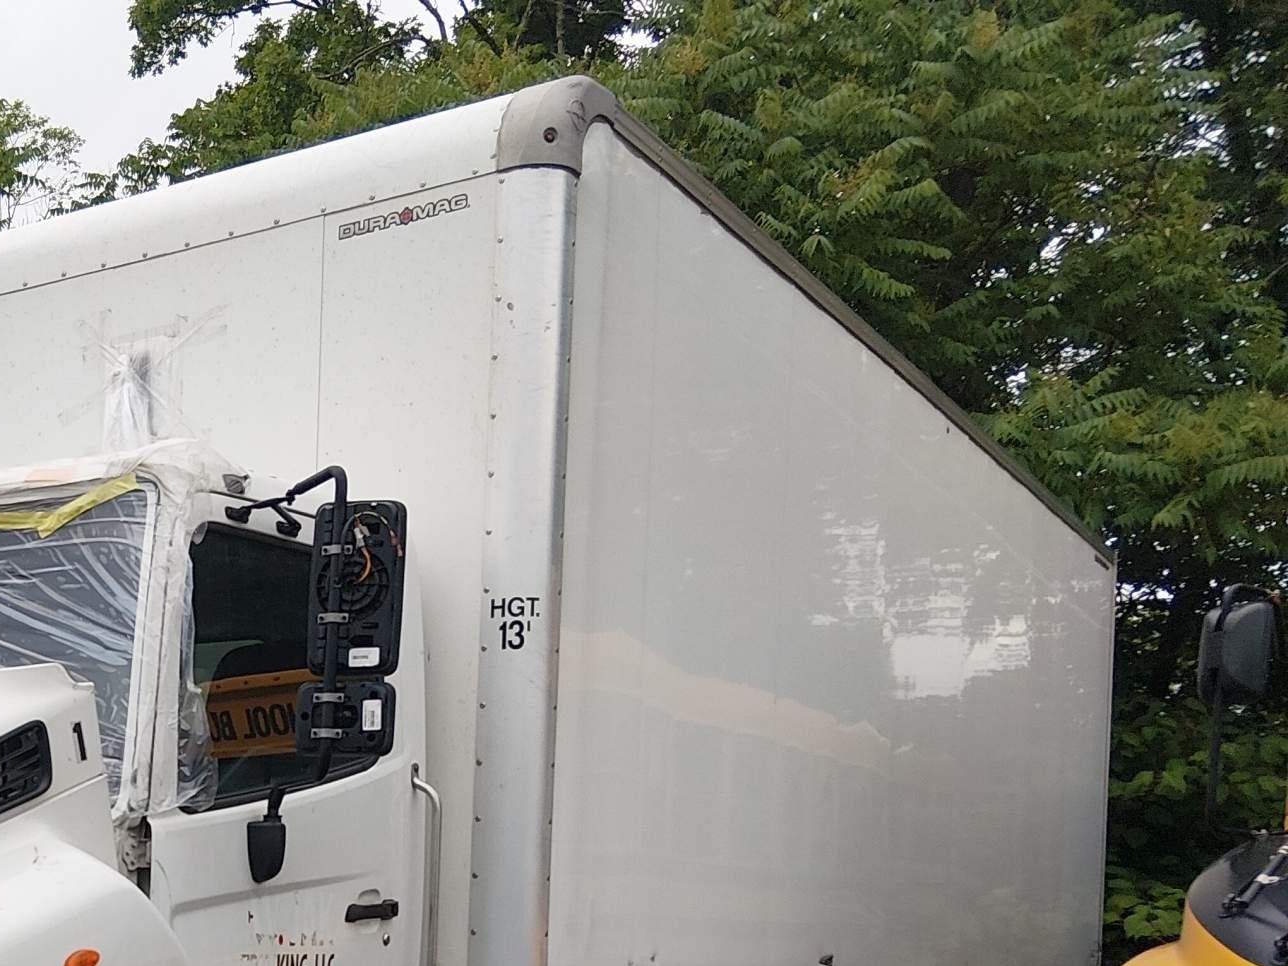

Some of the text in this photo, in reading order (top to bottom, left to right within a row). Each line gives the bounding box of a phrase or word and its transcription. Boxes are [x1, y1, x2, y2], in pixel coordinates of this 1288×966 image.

[490, 597, 540, 618] HGT.
[498, 620, 531, 650] 13'
[72, 721, 87, 761] 1
